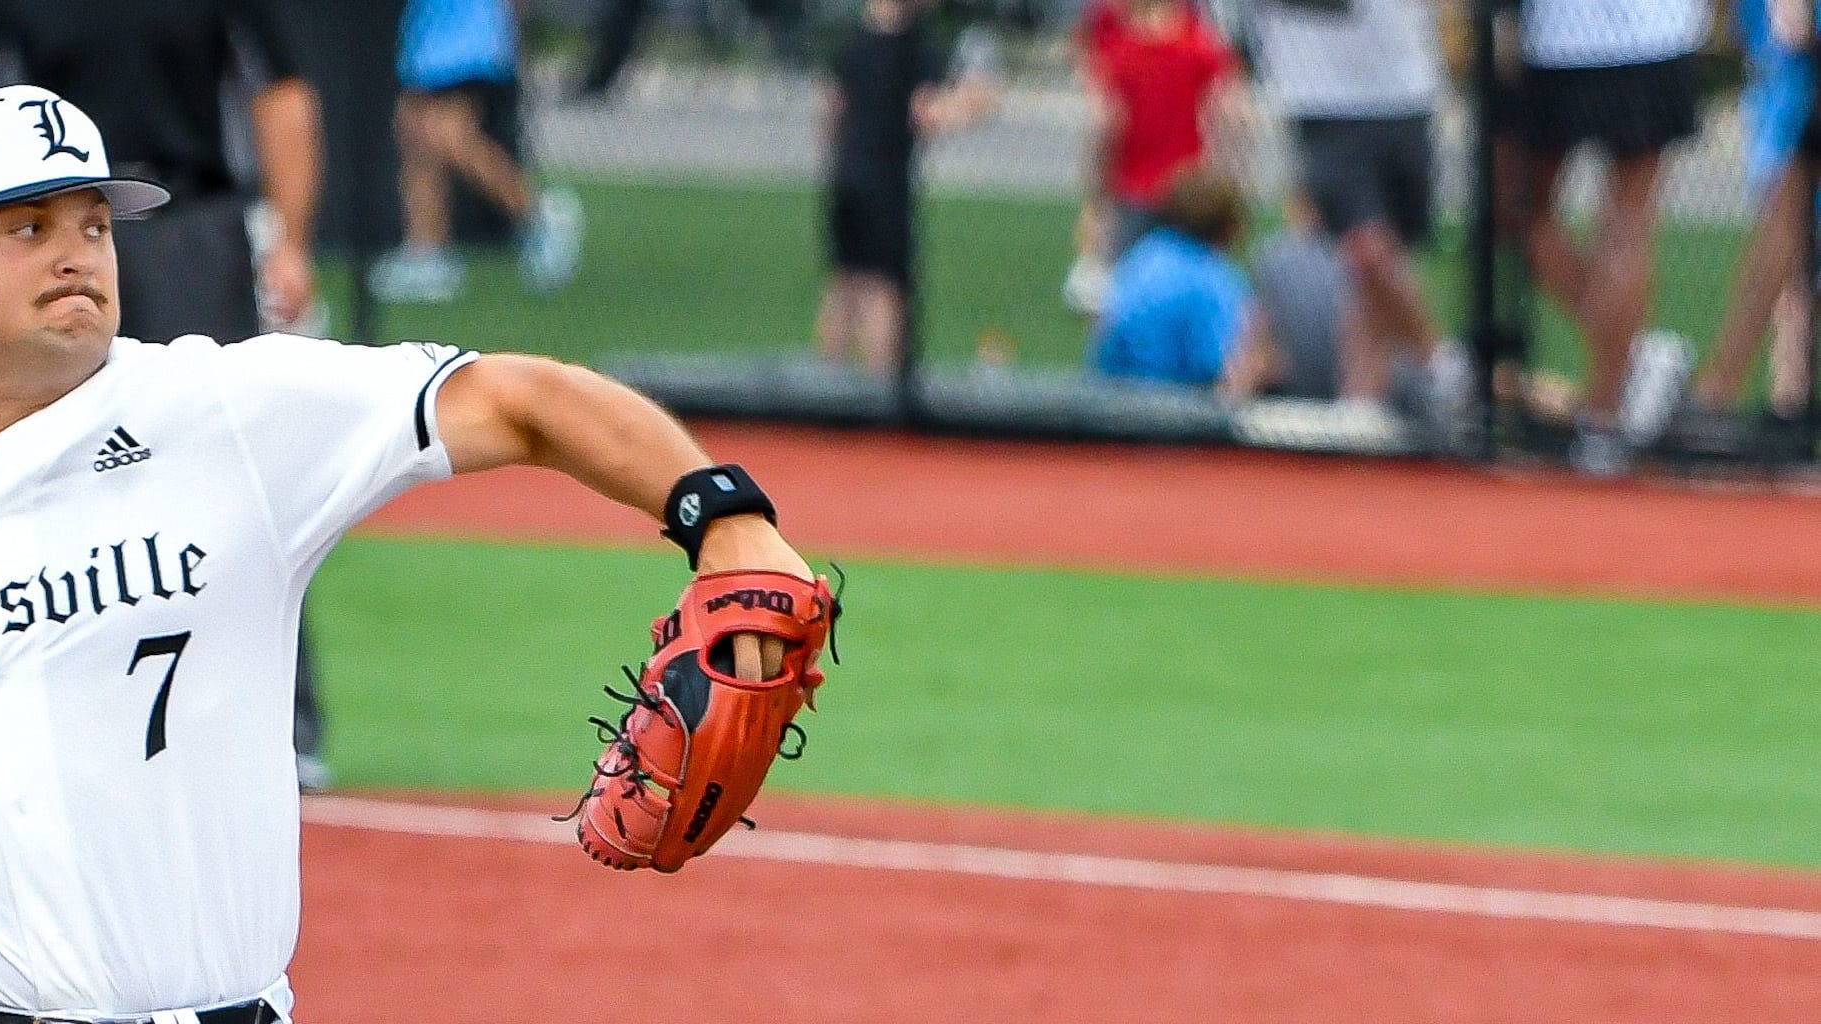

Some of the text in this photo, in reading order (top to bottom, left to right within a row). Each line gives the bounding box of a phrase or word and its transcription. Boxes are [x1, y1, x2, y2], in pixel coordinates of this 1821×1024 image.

[18, 98, 89, 163] L
[93, 447, 152, 473] adidas
[126, 628, 192, 761] 7
